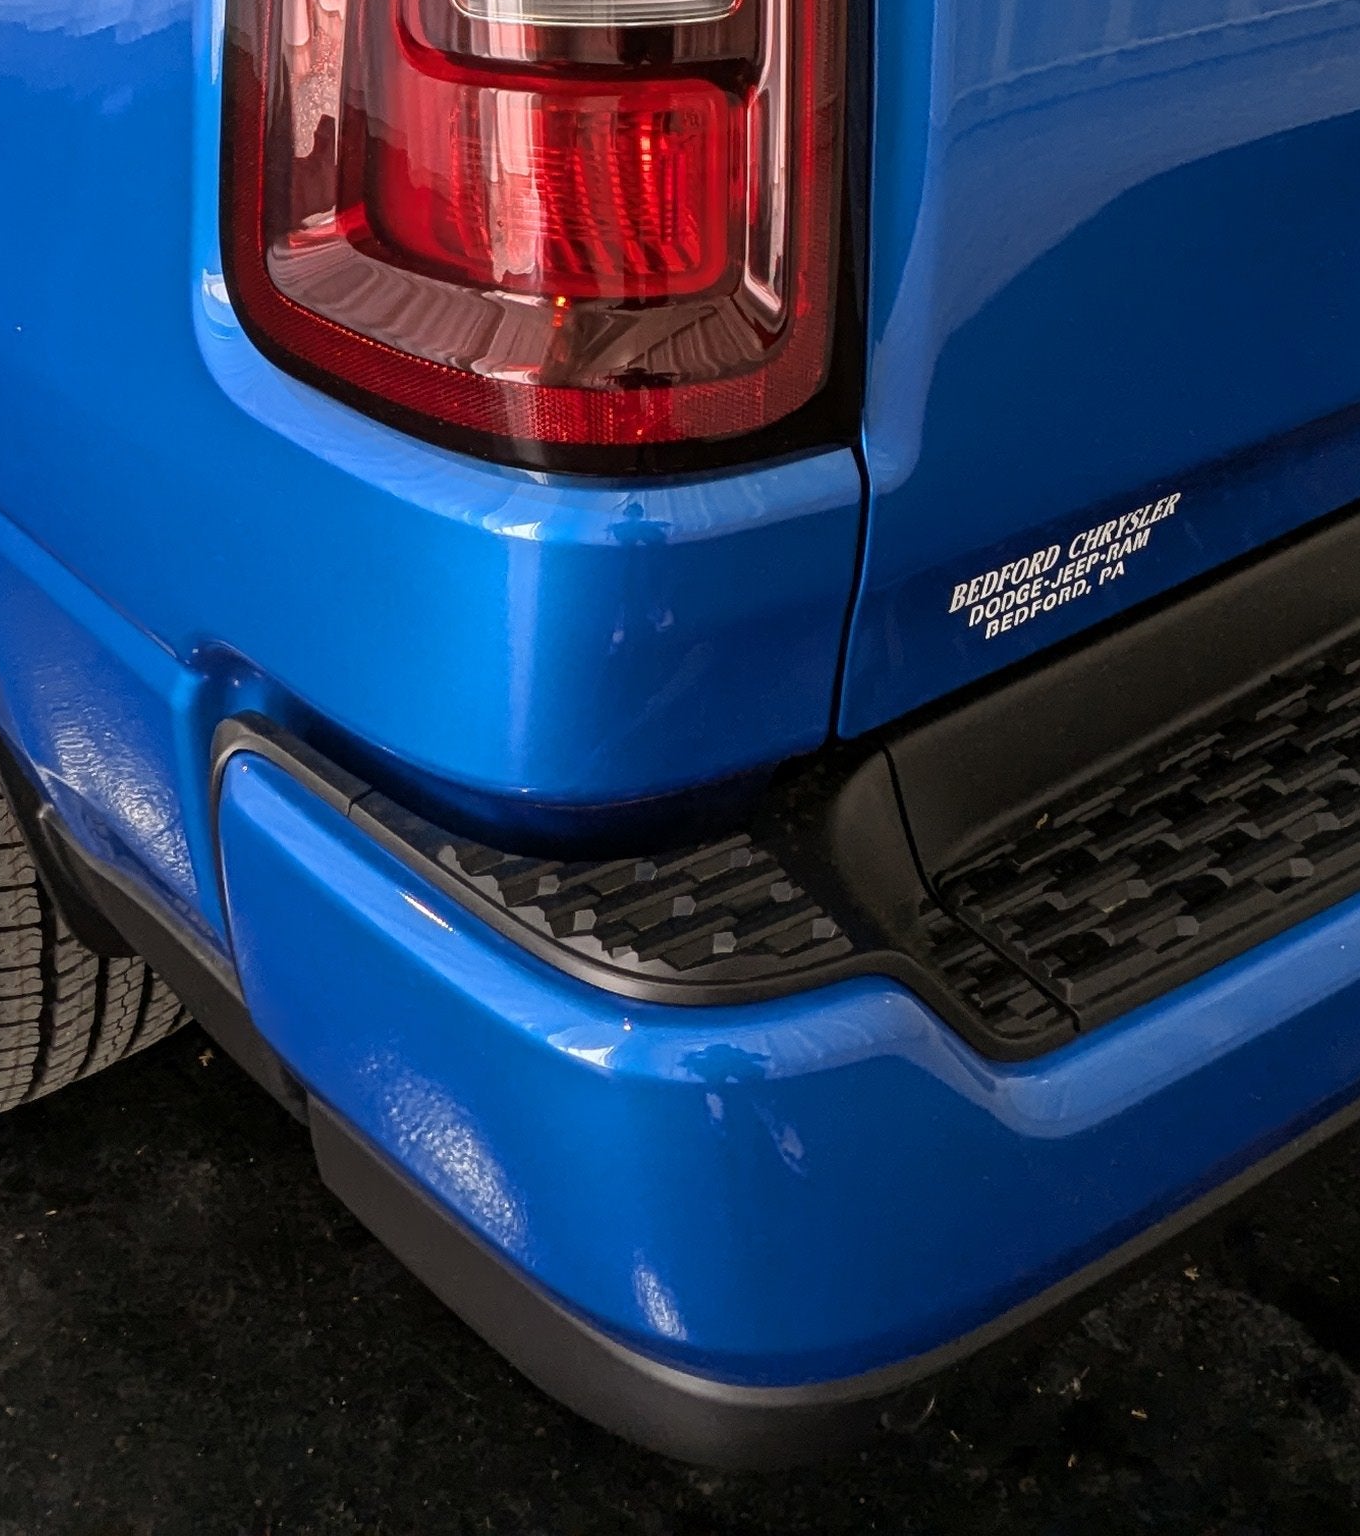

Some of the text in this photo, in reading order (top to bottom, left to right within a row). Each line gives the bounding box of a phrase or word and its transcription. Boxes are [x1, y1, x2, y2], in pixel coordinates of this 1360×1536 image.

[948, 492, 1182, 614] BEDFORD CHRYSLER
[984, 560, 1125, 640] BEDFORD, PA
